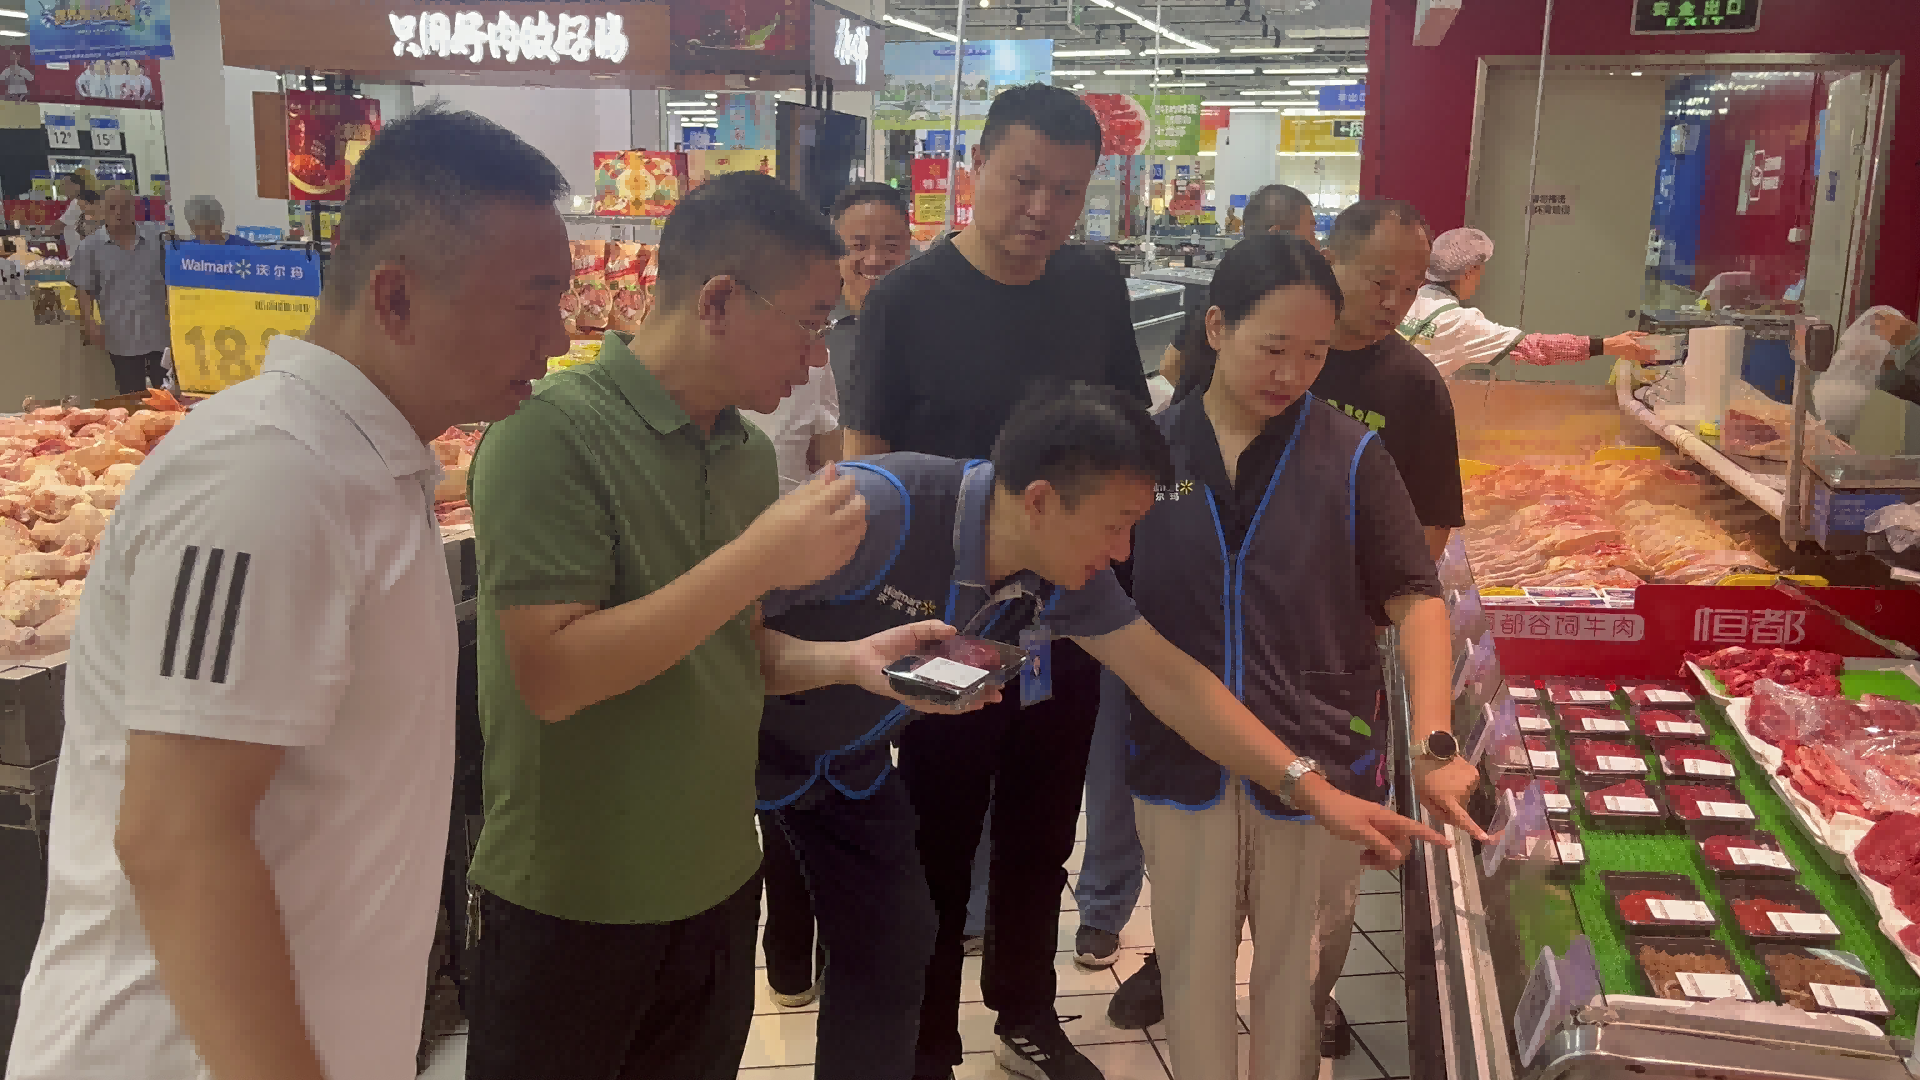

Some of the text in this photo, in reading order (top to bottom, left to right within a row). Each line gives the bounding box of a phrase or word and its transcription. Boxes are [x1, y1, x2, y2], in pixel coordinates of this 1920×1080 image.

[1652, 0, 1742, 16] 安全出口
[1665, 16, 1725, 27] EXIT
[181, 258, 233, 274] Walmart
[256, 264, 304, 279] 沃尔玛
[1155, 492, 1180, 502] 尔玛
[1694, 607, 1806, 644] 恒都
